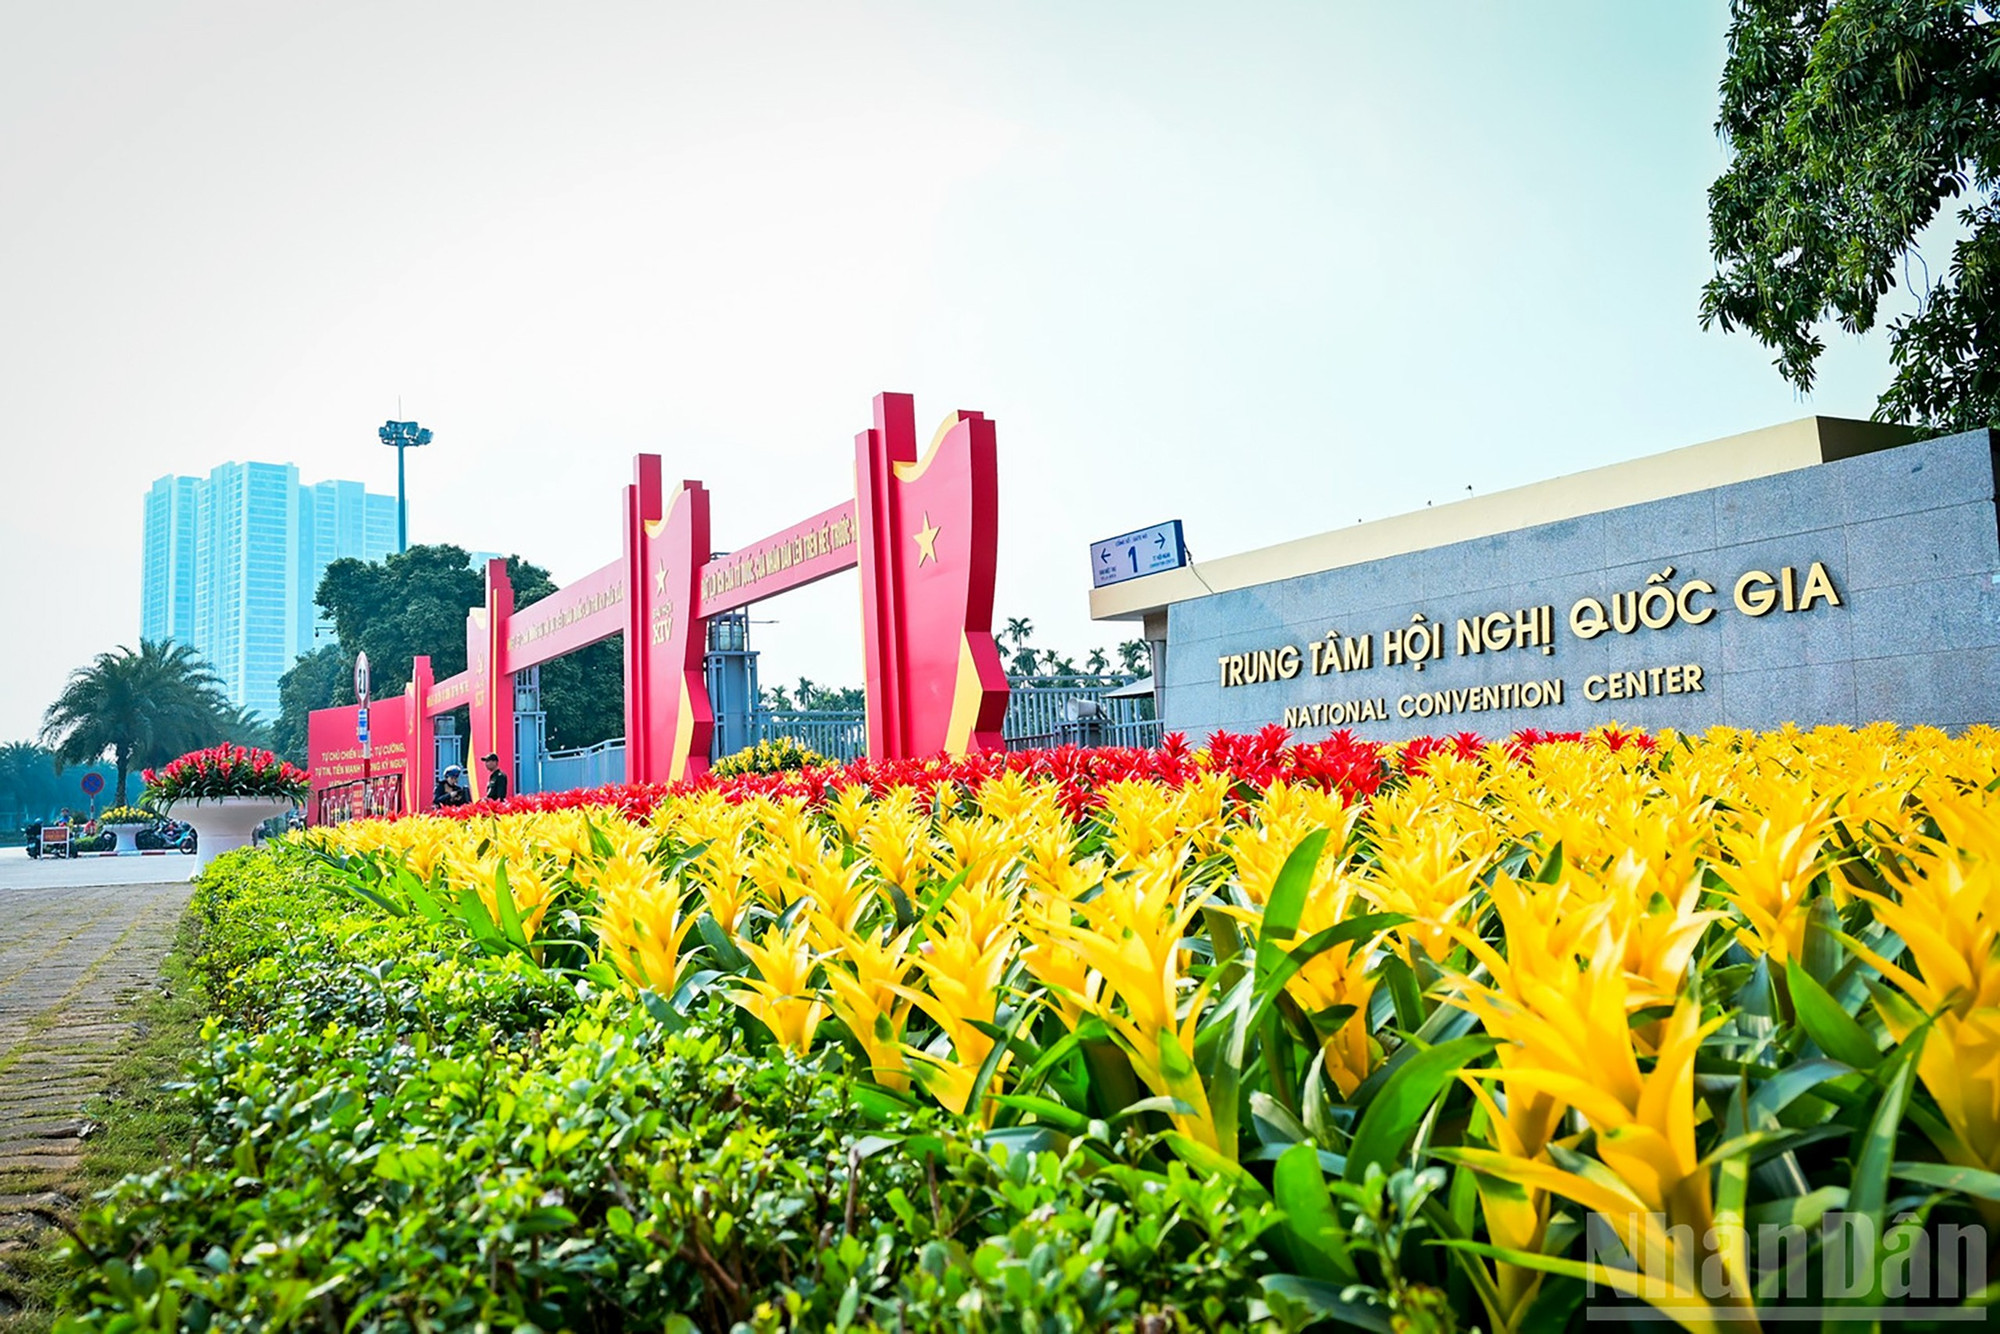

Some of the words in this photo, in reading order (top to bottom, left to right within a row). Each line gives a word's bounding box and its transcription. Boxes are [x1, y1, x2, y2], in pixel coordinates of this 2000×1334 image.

[1128, 545, 1138, 573] 1
[653, 617, 673, 646] XIV
[1218, 645, 1301, 687] TRUNG
[1309, 630, 1371, 675] TÂM
[1383, 613, 1442, 671] HỘI
[1457, 605, 1553, 656] NGHỊ
[1570, 566, 1715, 639] QUỐC
[1734, 562, 1841, 617] GIA
[1284, 698, 1389, 728] NATIONAL
[1398, 678, 1563, 718] CONVENTION
[1583, 664, 1704, 702] CENTER
